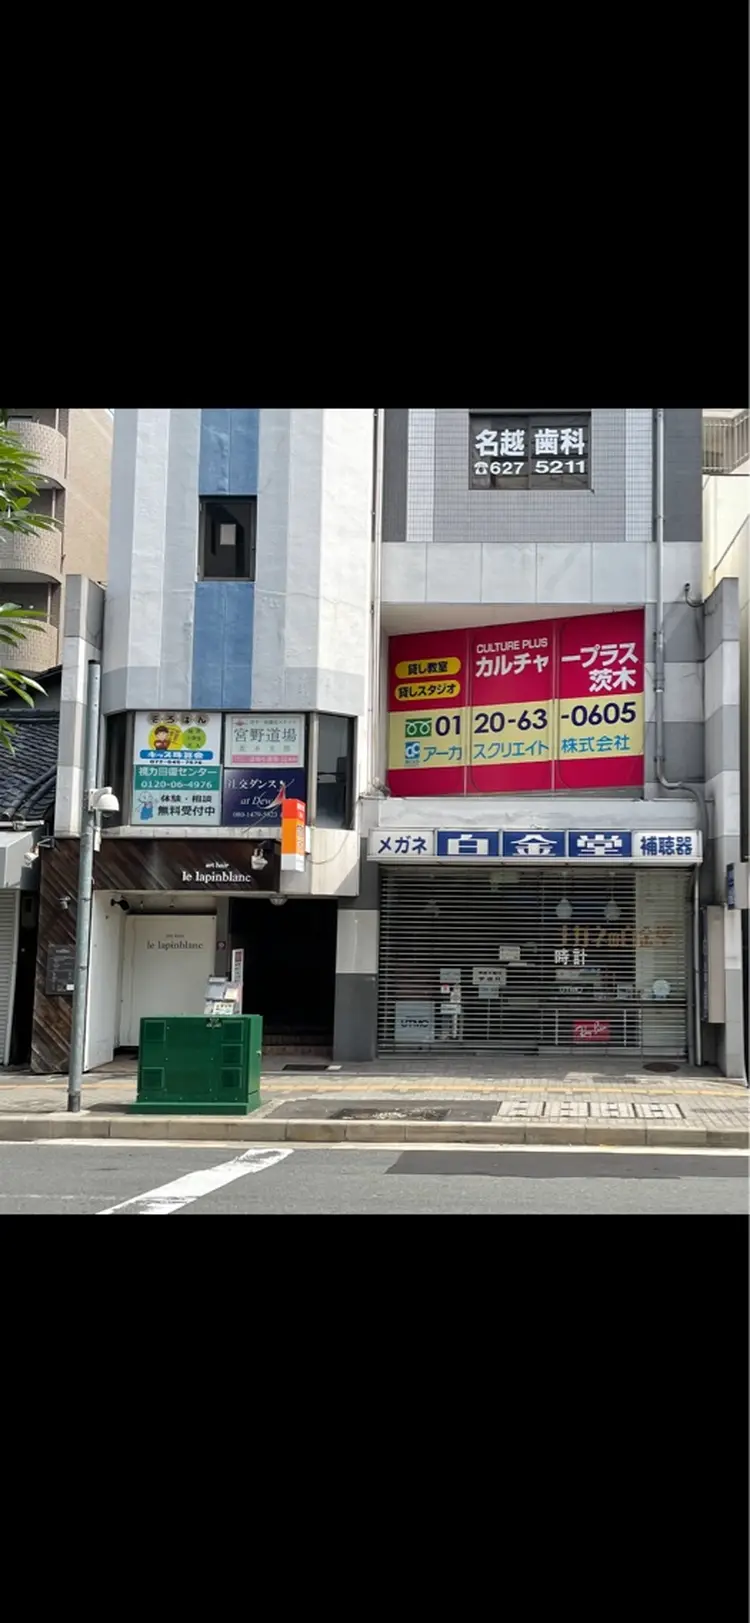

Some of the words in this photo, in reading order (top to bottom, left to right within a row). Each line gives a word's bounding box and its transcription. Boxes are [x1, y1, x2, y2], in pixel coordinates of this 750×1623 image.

[475, 429, 525, 457] 名越
[534, 428, 585, 456] 歯科
[490, 462, 524, 475] 627
[535, 460, 585, 474] 5211
[476, 640, 520, 654] CULTURE
[522, 638, 548, 649] PLUS
[408, 661, 448, 676] 貸し教室
[589, 667, 636, 692] 茨木
[398, 683, 456, 698] 貸しスタジオ
[234, 727, 297, 742] 宮野道場
[561, 735, 630, 753] 株式会社
[158, 806, 215, 816] 無料受付中
[378, 836, 427, 854] メガネ
[447, 833, 623, 856] 白金堂
[640, 836, 693, 856] 補聴器
[182, 871, 193, 882] le
[195, 871, 251, 883] lapinblanc
[147, 940, 155, 949] le
[157, 940, 203, 950] lapinblanc
[554, 948, 588, 965] 時計
